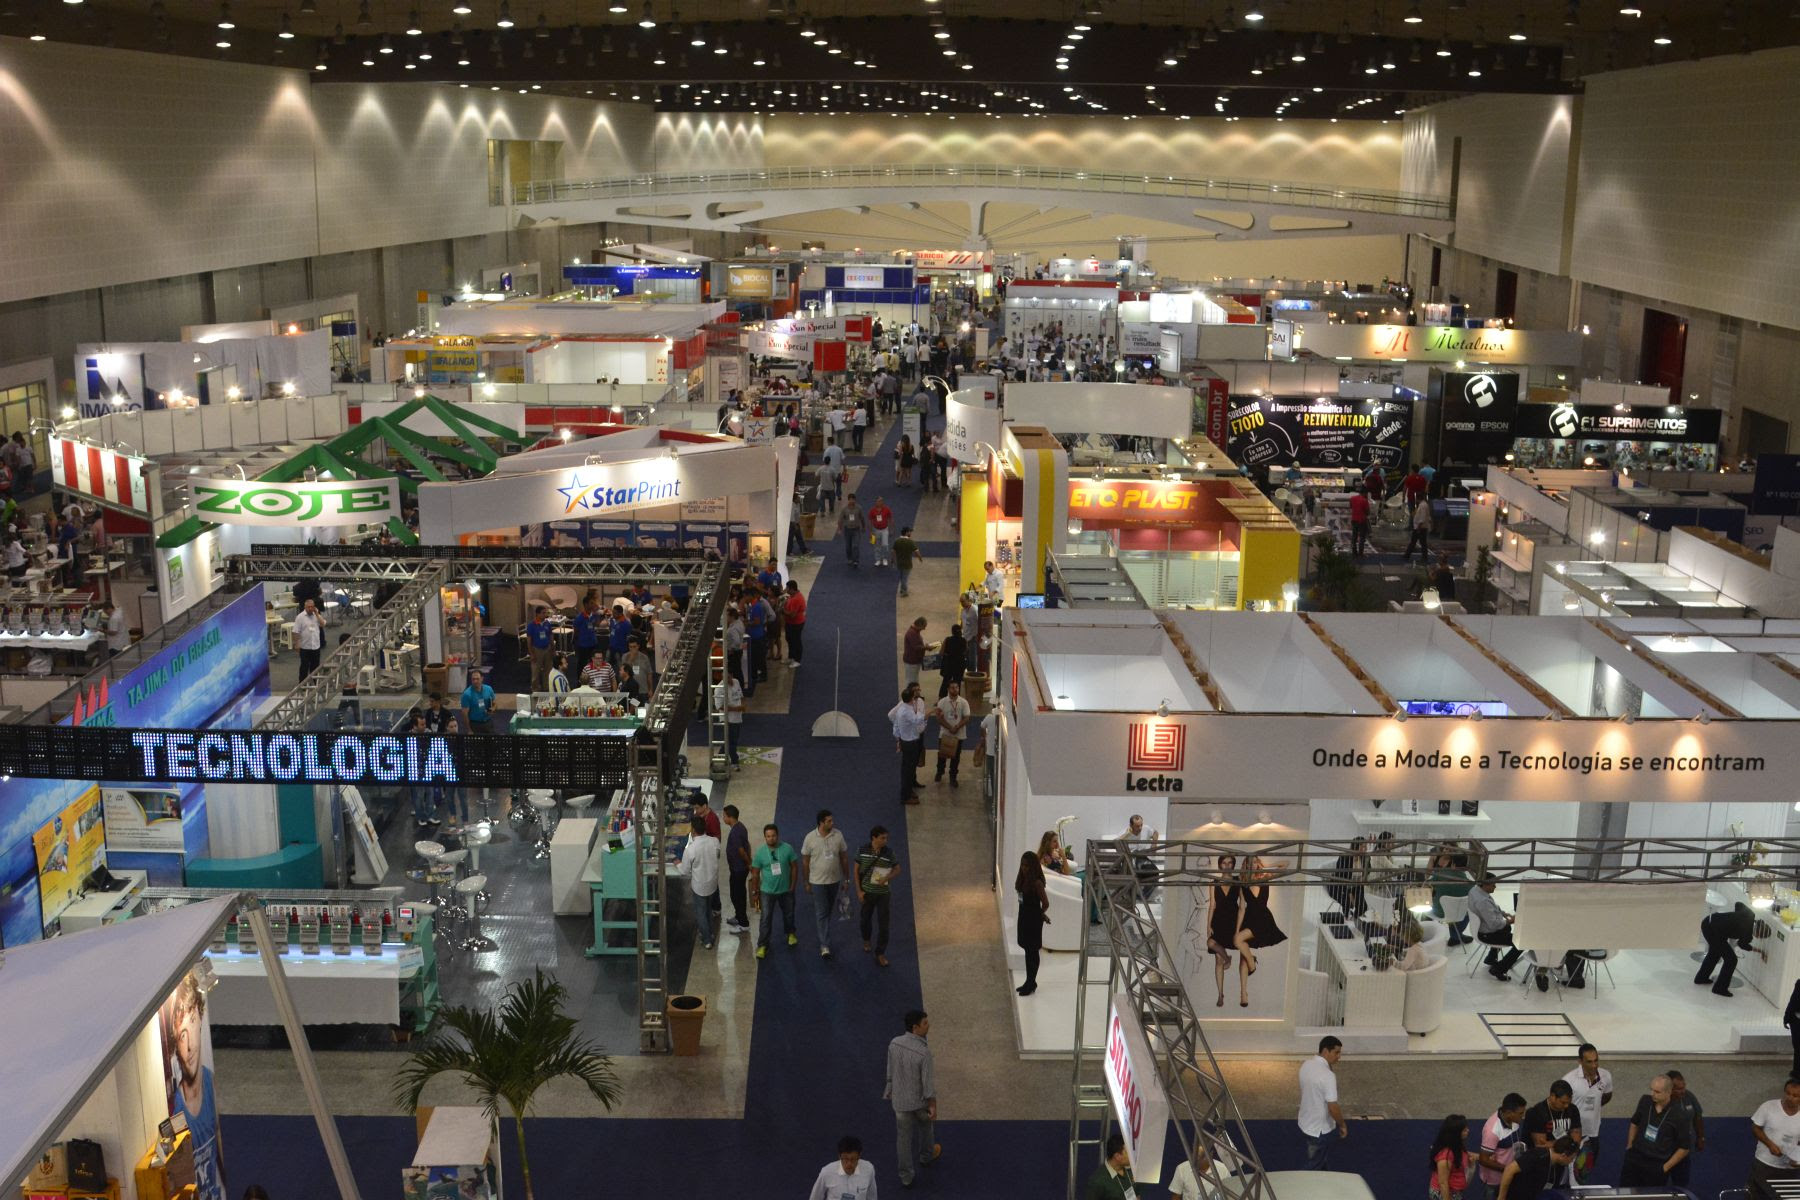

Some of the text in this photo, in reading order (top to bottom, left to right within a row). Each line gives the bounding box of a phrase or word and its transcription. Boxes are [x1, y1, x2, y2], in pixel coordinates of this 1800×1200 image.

[807, 321, 837, 333] Special
[784, 340, 809, 352] Special
[1424, 333, 1505, 352] Metalnox
[1231, 411, 1265, 437] F7070
[1480, 421, 1509, 430] EPSON
[1598, 416, 1688, 430] SUPRIMENTOS
[194, 486, 390, 521] ZOJE
[592, 479, 681, 508] StarPrint
[1122, 489, 1199, 510] PLAST
[127, 626, 222, 709] TAJIMA DO BRASIL
[132, 732, 460, 783] TECNOLOGIA
[1312, 748, 1765, 775] Onde a Moda e a Tecnologia se encontram
[1126, 772, 1183, 792] Lectra
